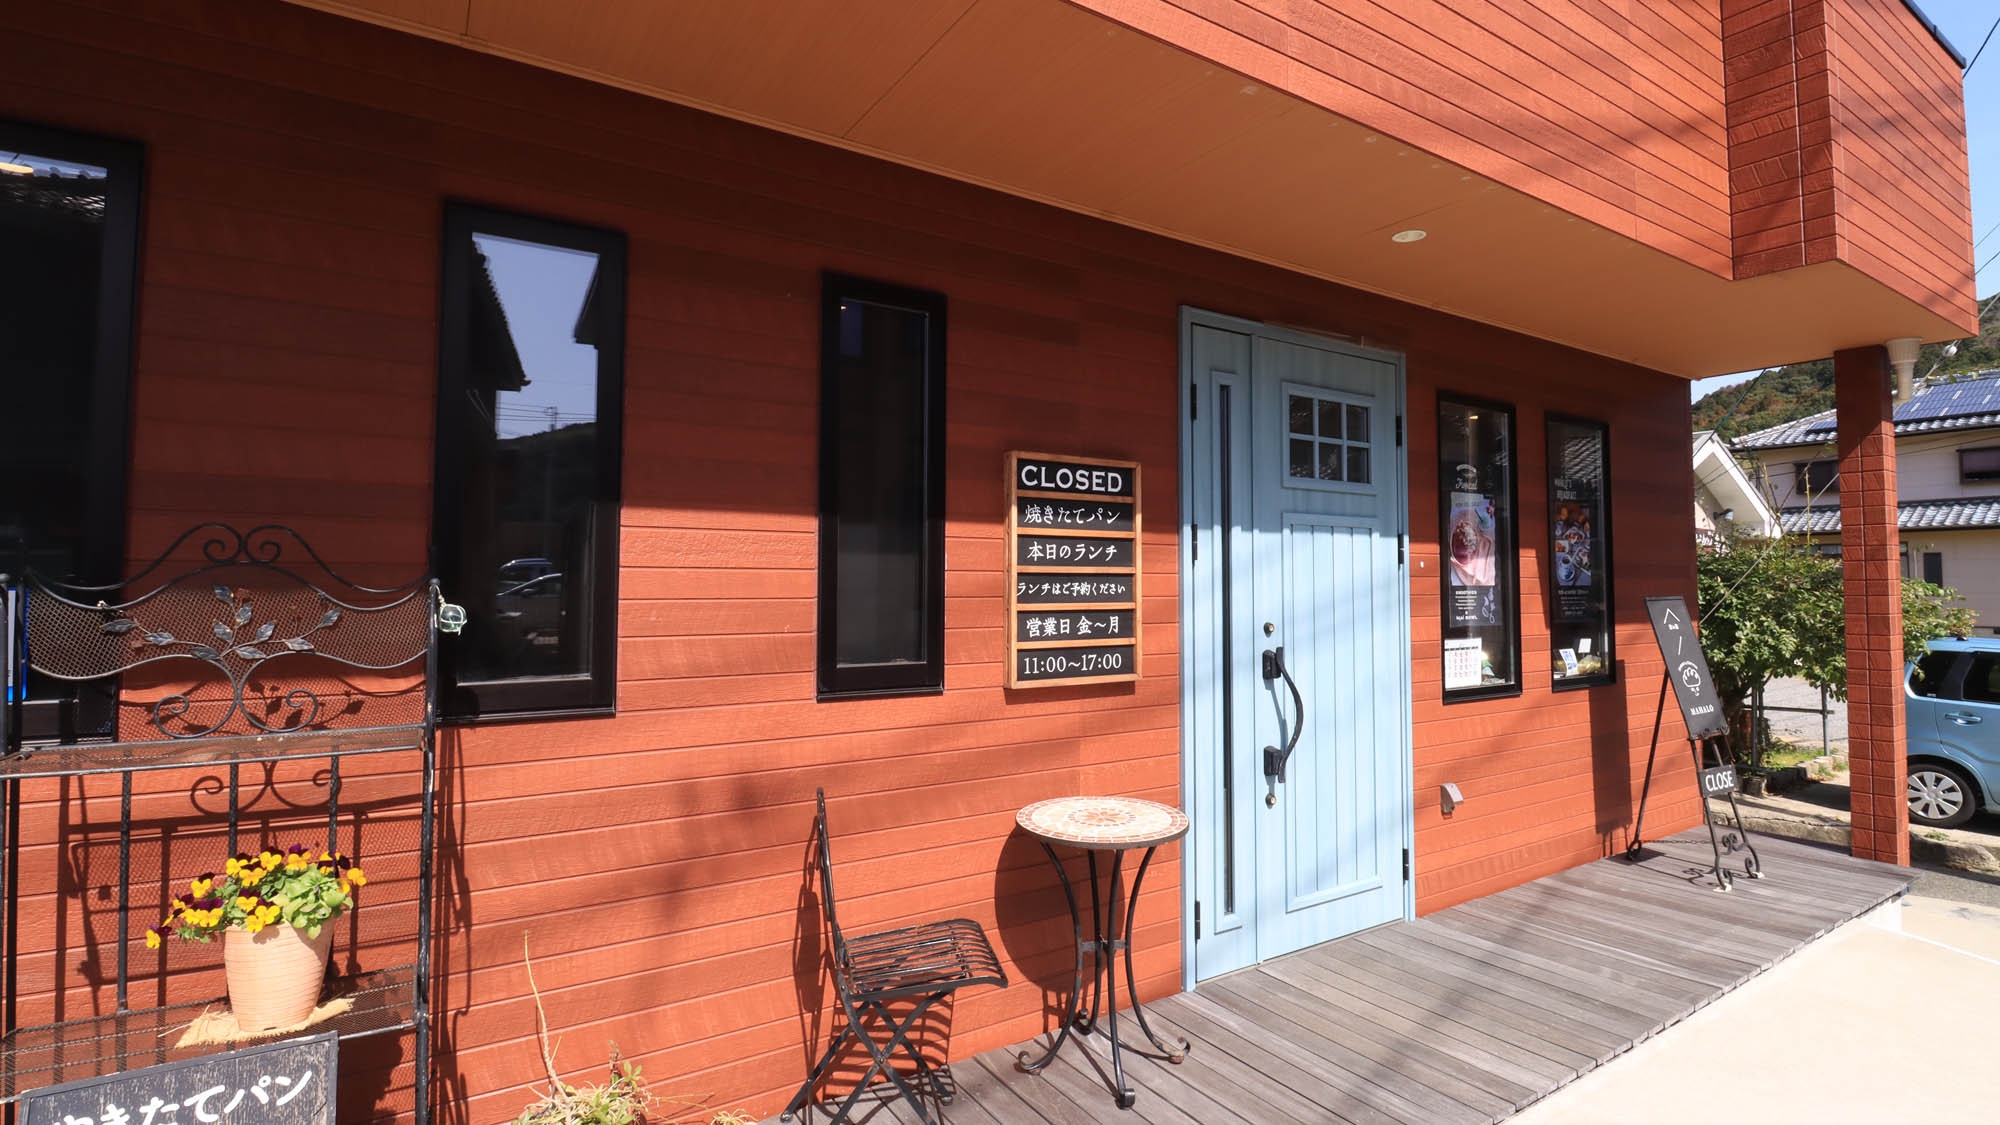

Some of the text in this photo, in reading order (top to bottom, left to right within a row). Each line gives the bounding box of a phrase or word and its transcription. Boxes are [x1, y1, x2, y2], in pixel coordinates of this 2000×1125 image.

[1021, 465, 1122, 493] CLOSED
[1023, 504, 1120, 525] 焼きたてパン
[1026, 541, 1118, 562] 本日のランチ
[1016, 582, 1126, 597] ランチはご予約ください
[1026, 617, 1071, 638] 営業日
[1705, 769, 1734, 793] CLOSE
